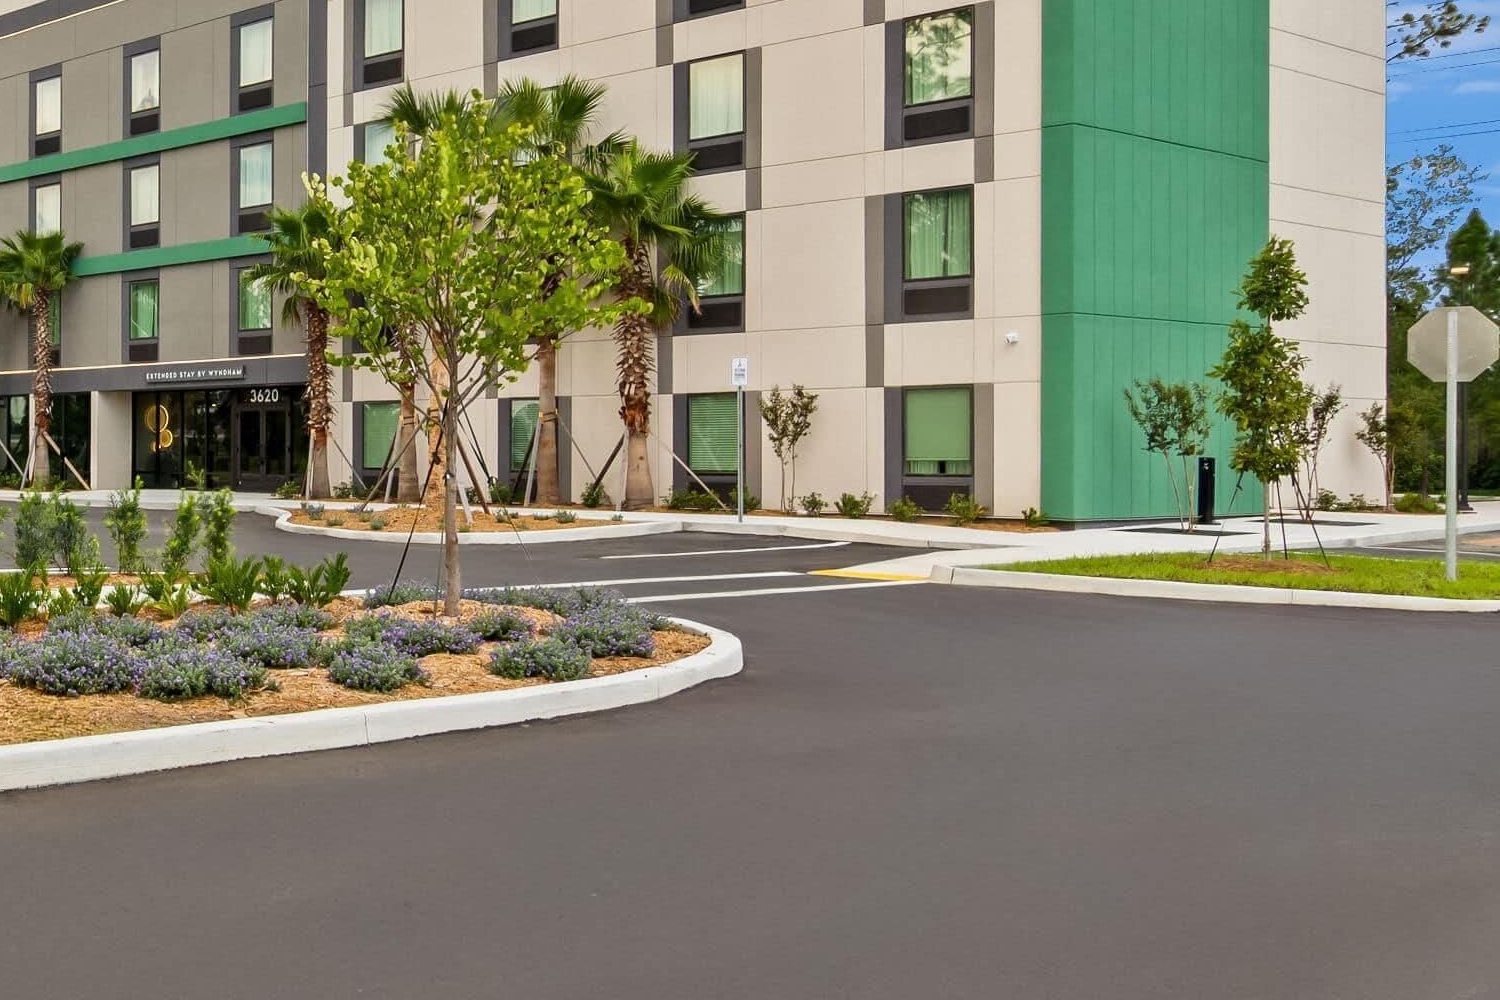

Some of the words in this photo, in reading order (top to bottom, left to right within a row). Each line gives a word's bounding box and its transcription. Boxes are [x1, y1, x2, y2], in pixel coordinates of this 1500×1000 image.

[146, 372, 177, 380] EXTENDED
[179, 371, 195, 379] STAY
[208, 368, 242, 376] WYNDHAM
[250, 388, 279, 403] 3620
